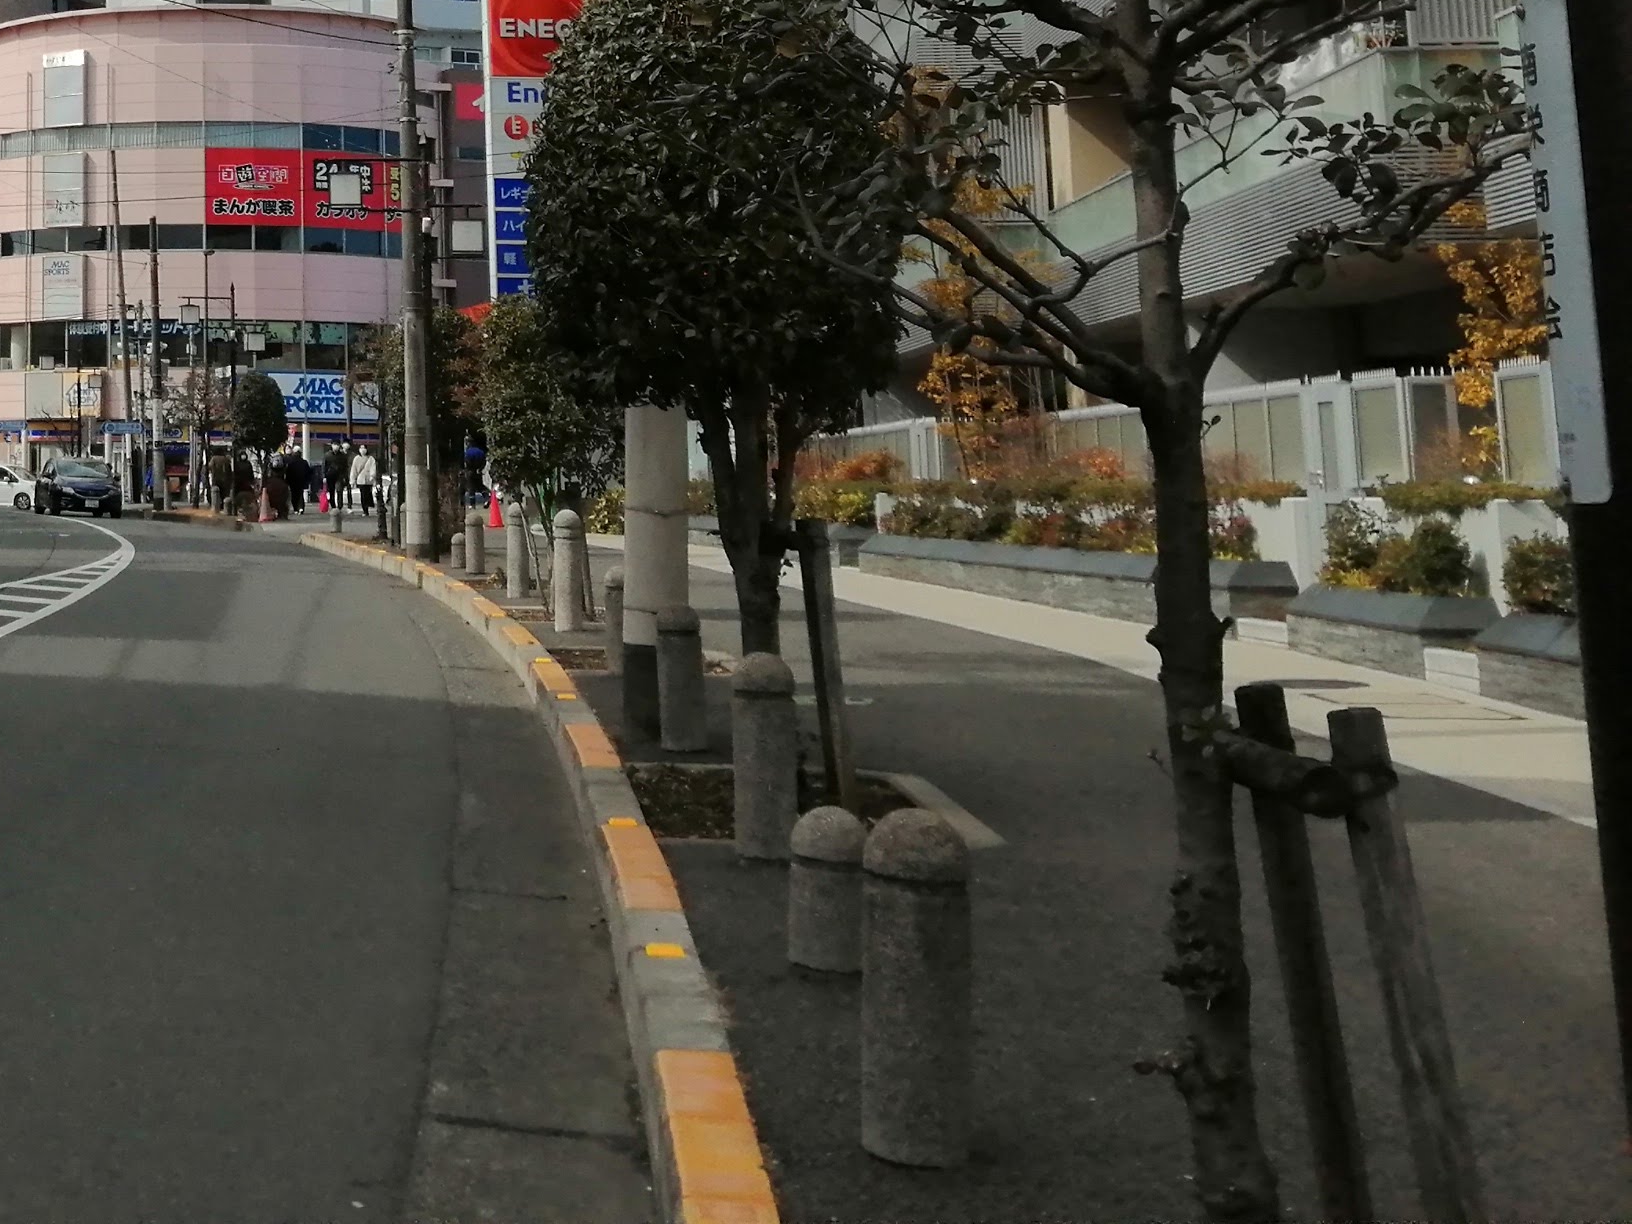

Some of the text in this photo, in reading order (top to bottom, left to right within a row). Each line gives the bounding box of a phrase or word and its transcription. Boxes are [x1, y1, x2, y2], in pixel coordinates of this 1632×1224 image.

[499, 17, 571, 40] ENEO
[293, 378, 344, 395] MAC
[283, 396, 345, 414] PORTS
